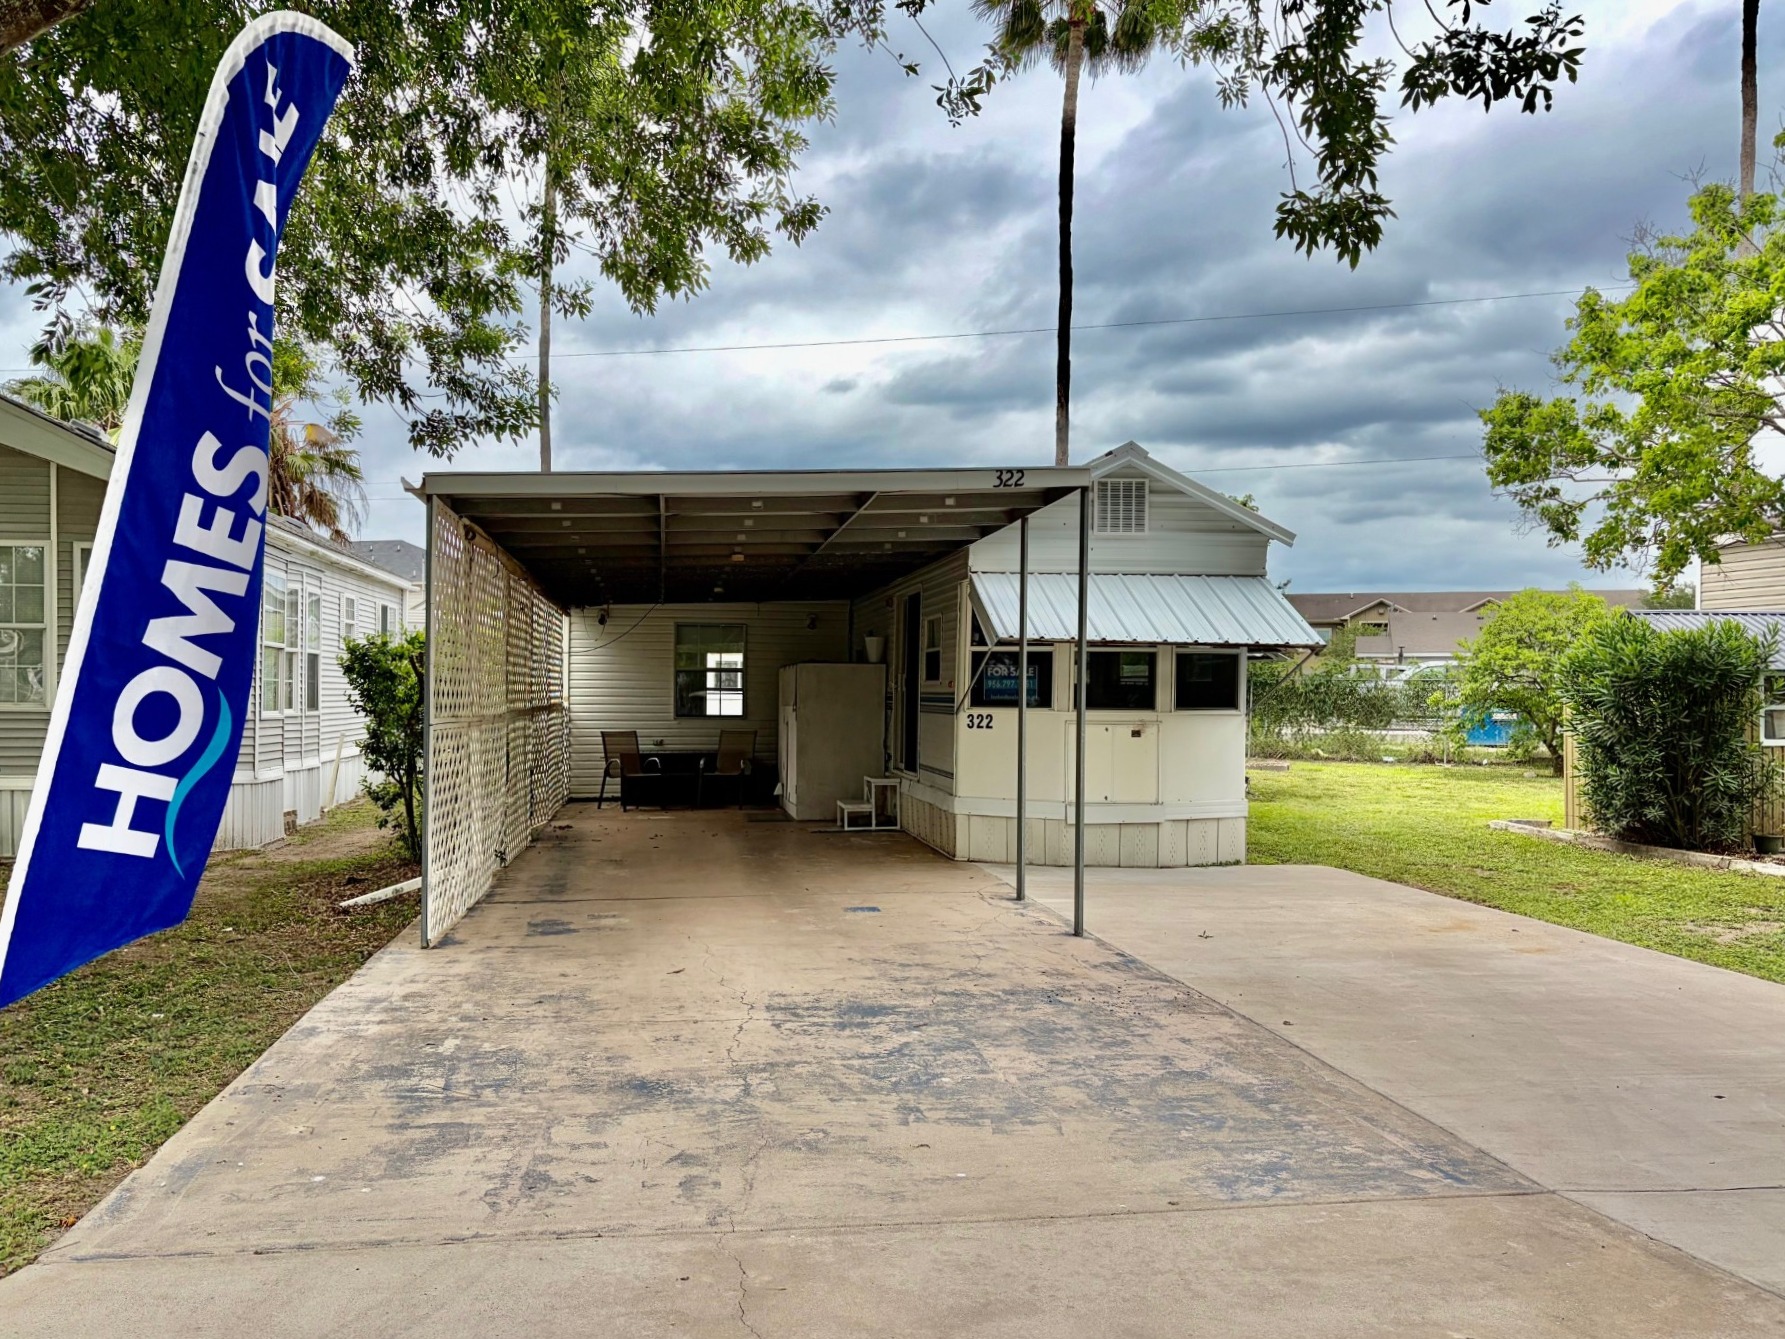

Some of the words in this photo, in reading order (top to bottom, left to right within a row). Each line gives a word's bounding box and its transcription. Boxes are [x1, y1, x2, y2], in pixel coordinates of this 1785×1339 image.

[993, 469, 1025, 488] 322
[77, 430, 269, 858] HOMES
[214, 310, 274, 423] for
[987, 667, 1009, 677] FOR
[1010, 667, 1035, 677] SE
[966, 713, 993, 729] 322
